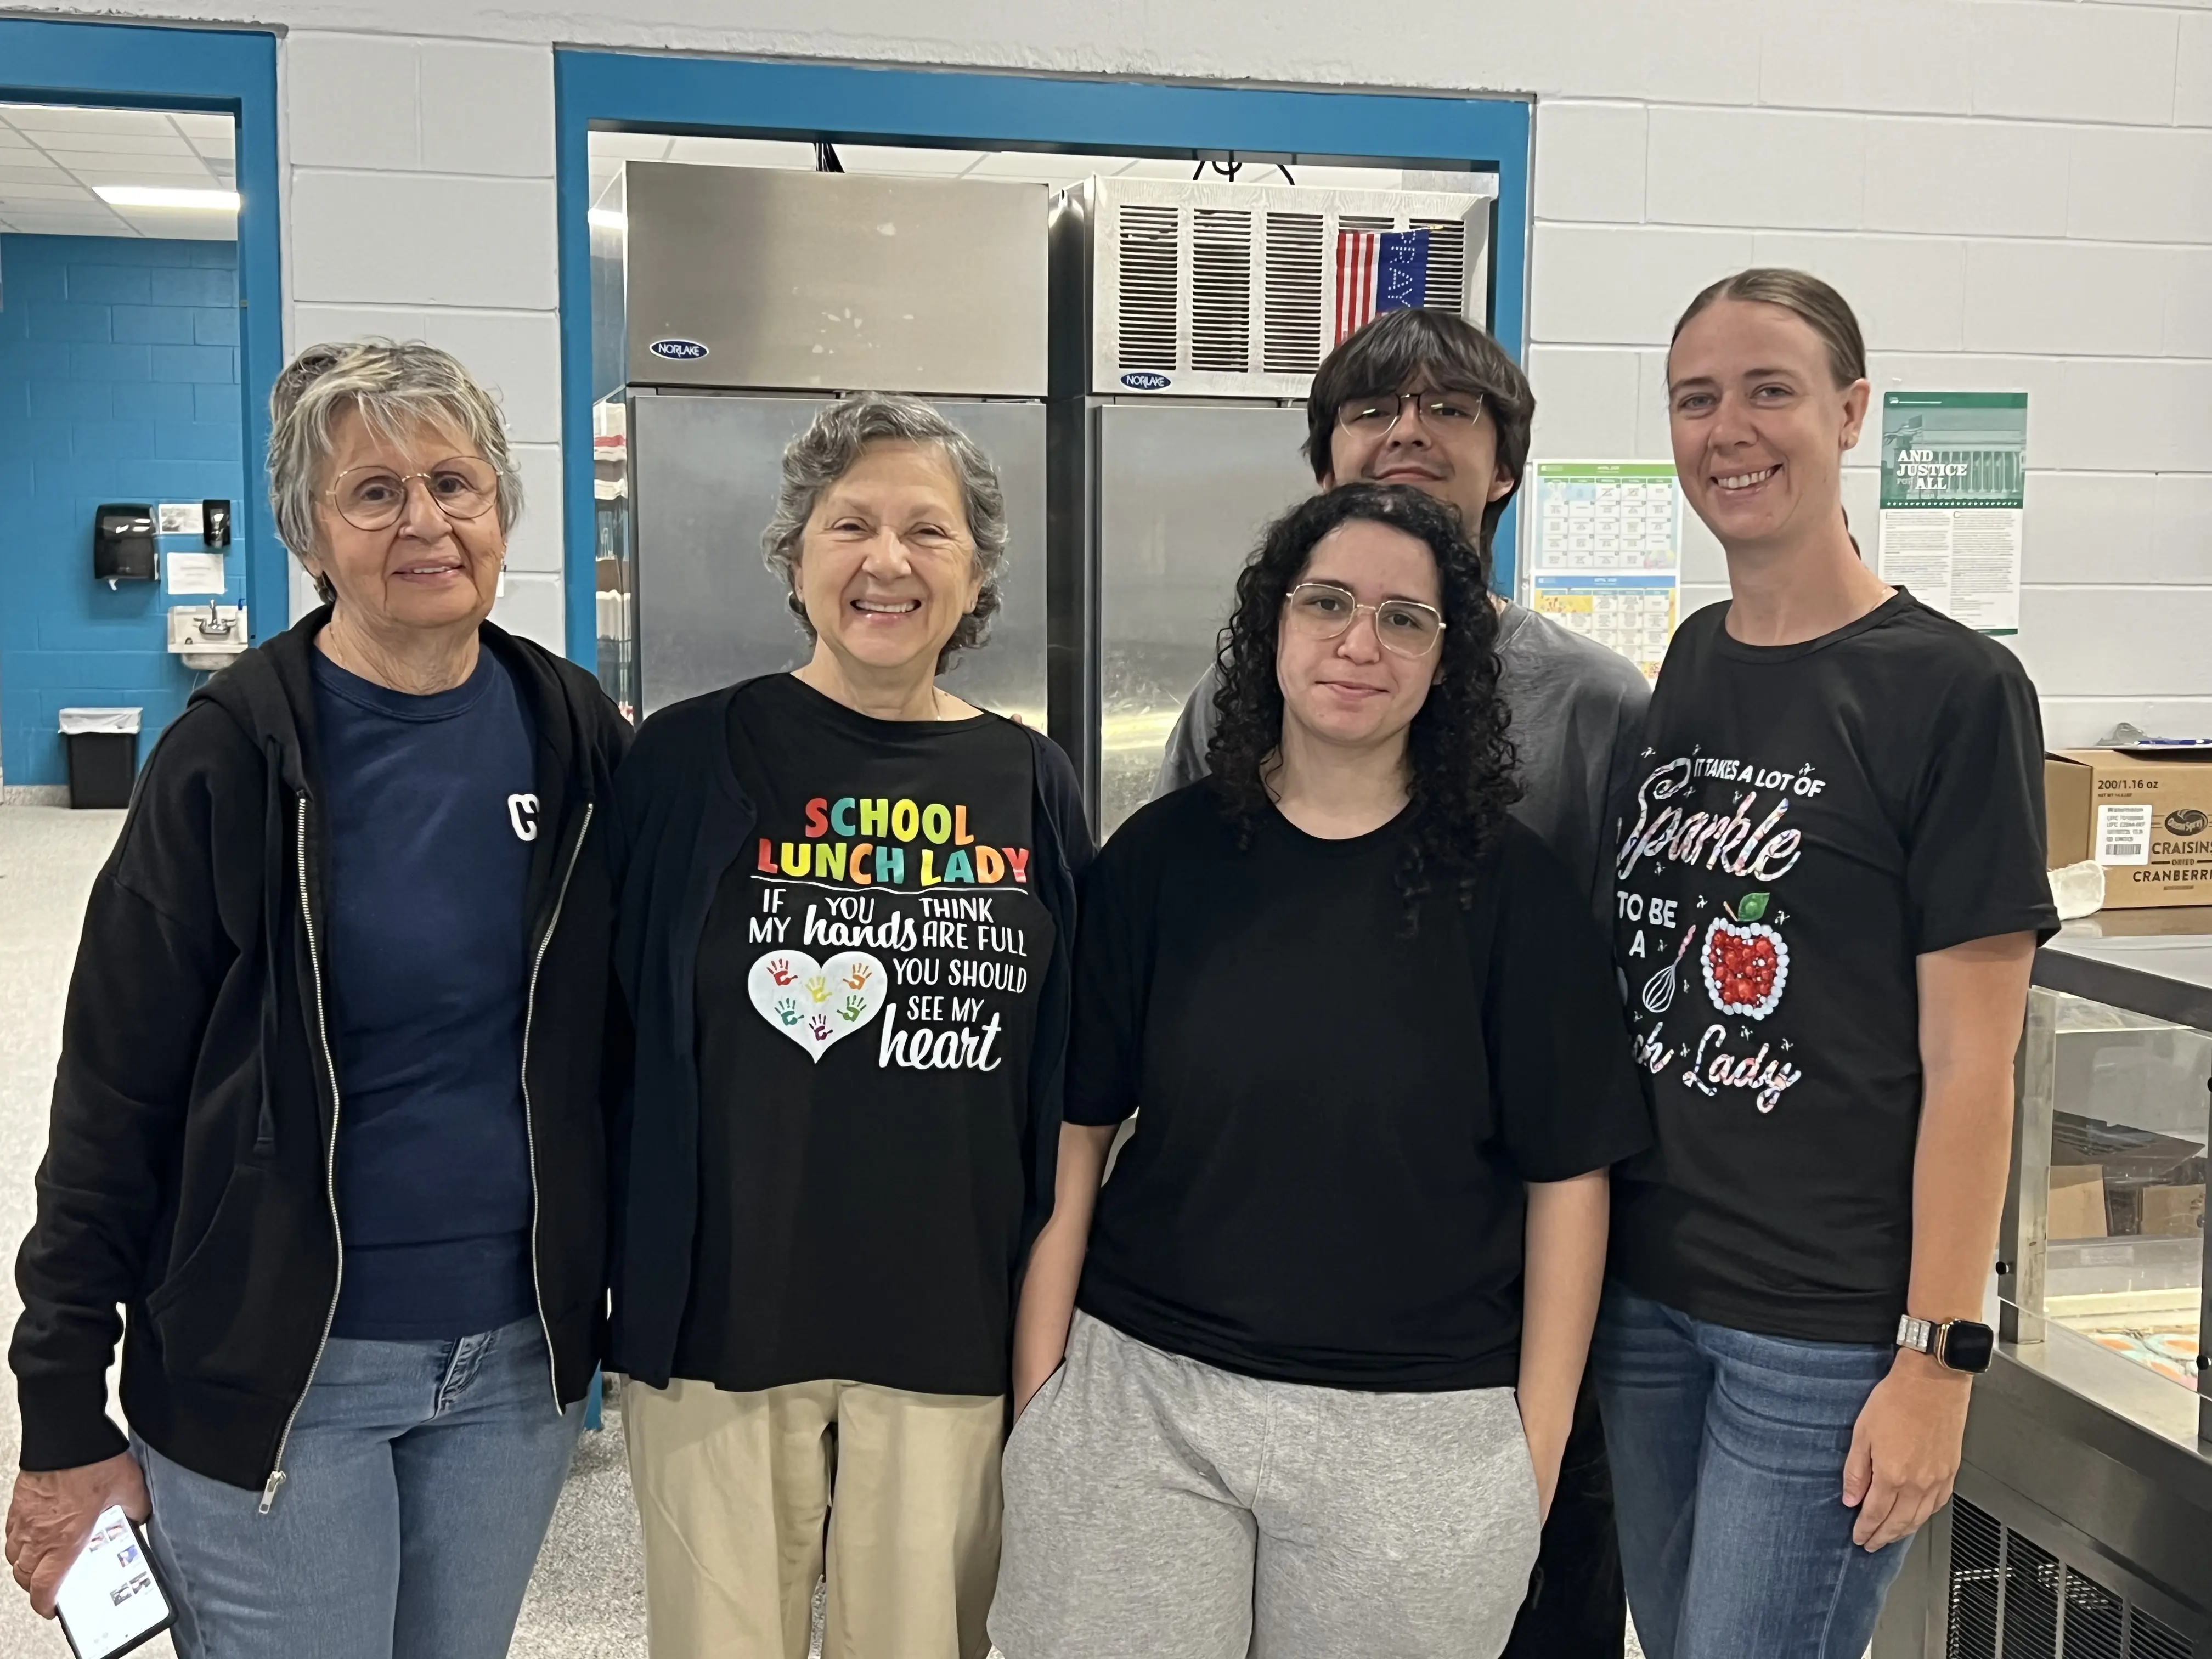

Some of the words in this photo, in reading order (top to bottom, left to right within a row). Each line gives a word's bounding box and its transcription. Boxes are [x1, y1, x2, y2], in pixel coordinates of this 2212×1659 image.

[658, 343, 700, 358] NORLAKE
[1126, 375, 1164, 388] NORLAKE
[1896, 464, 1968, 476] JUSTICE
[1897, 450, 1934, 462] AND
[1915, 477, 1947, 490] ALL
[1693, 758, 1705, 777] IT
[1704, 759, 1740, 781] TAKES
[1737, 765, 1754, 782] A
[1754, 768, 1795, 791] LOT
[1793, 776, 1826, 797] OF
[2097, 780, 2144, 789] 200/1.16
[805, 797, 974, 846] SCHOOL
[1616, 757, 1802, 882] Sparkle
[758, 838, 905, 885] LUNCH
[921, 845, 1030, 887] LADY
[763, 888, 787, 914] IF
[825, 896, 875, 924] YOU
[919, 897, 994, 923] THINK
[1616, 890, 1643, 921] TO
[1649, 898, 1678, 929] BE
[749, 916, 791, 944] MY
[804, 904, 916, 952] hands
[923, 921, 968, 950] ARE
[978, 926, 1028, 957] FULL
[1629, 930, 1646, 958] A
[893, 958, 939, 986] YOU
[947, 959, 1028, 994] SHOULD
[907, 995, 945, 1022] SEE
[952, 998, 985, 1023] MY
[878, 1003, 1002, 1071] heart
[1682, 1024, 1802, 1114] Lady
